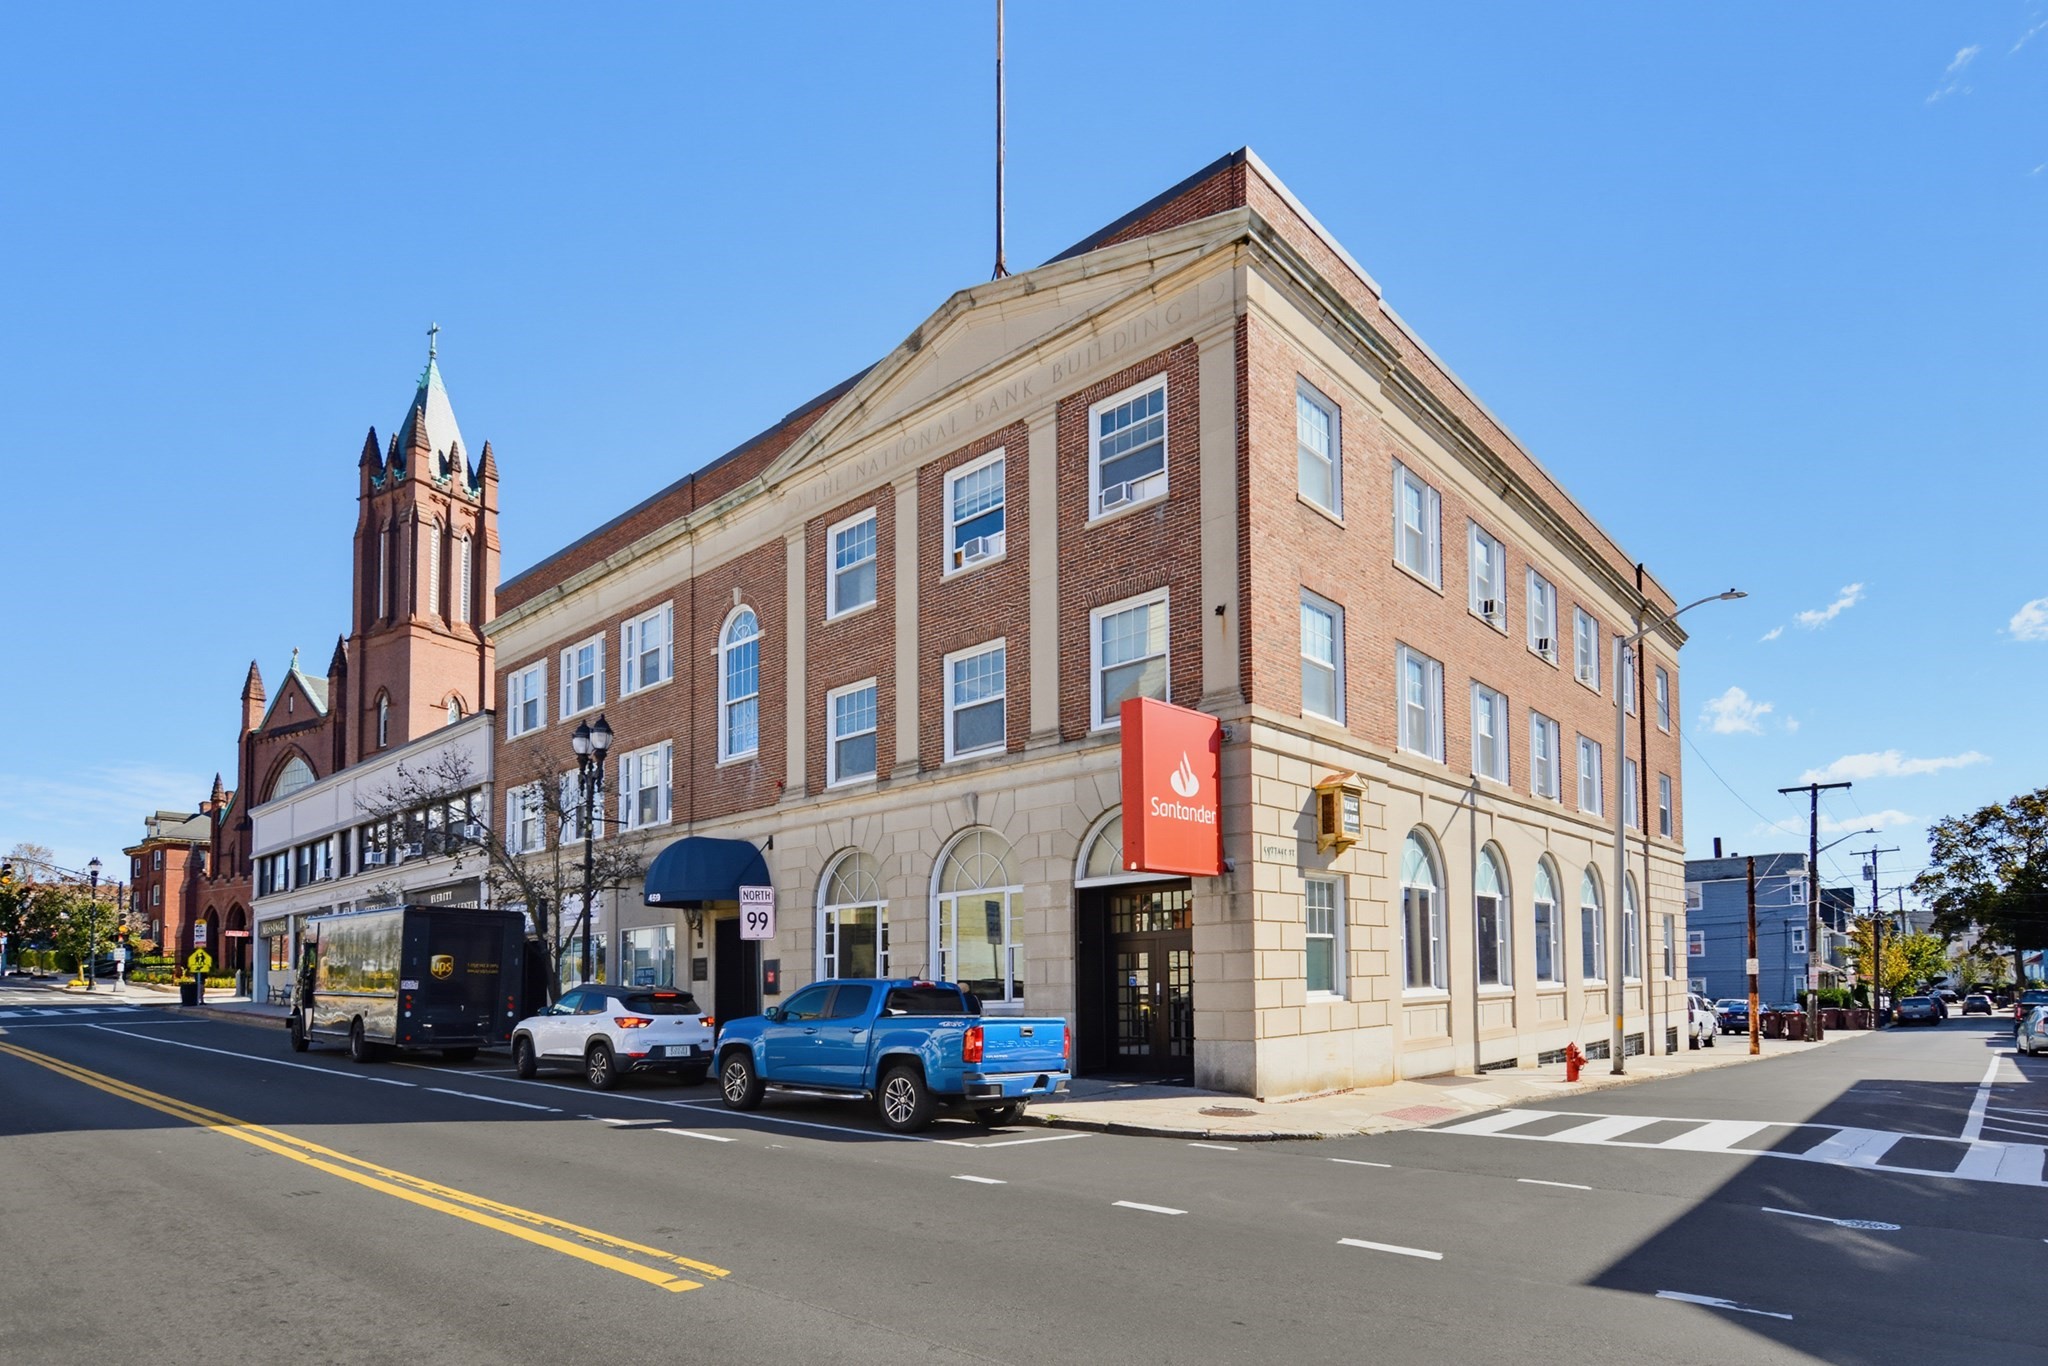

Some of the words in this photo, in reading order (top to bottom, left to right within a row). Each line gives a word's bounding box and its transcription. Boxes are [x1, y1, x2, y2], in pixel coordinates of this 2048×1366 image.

[811, 475, 841, 502] THE
[855, 415, 960, 482] NATIONAL
[975, 376, 1033, 423] BANK
[1052, 304, 1182, 385] BUILDING
[1151, 796, 1217, 825] Santander
[742, 890, 771, 901] NORTH
[746, 911, 768, 931] 99
[432, 962, 452, 976] ups
